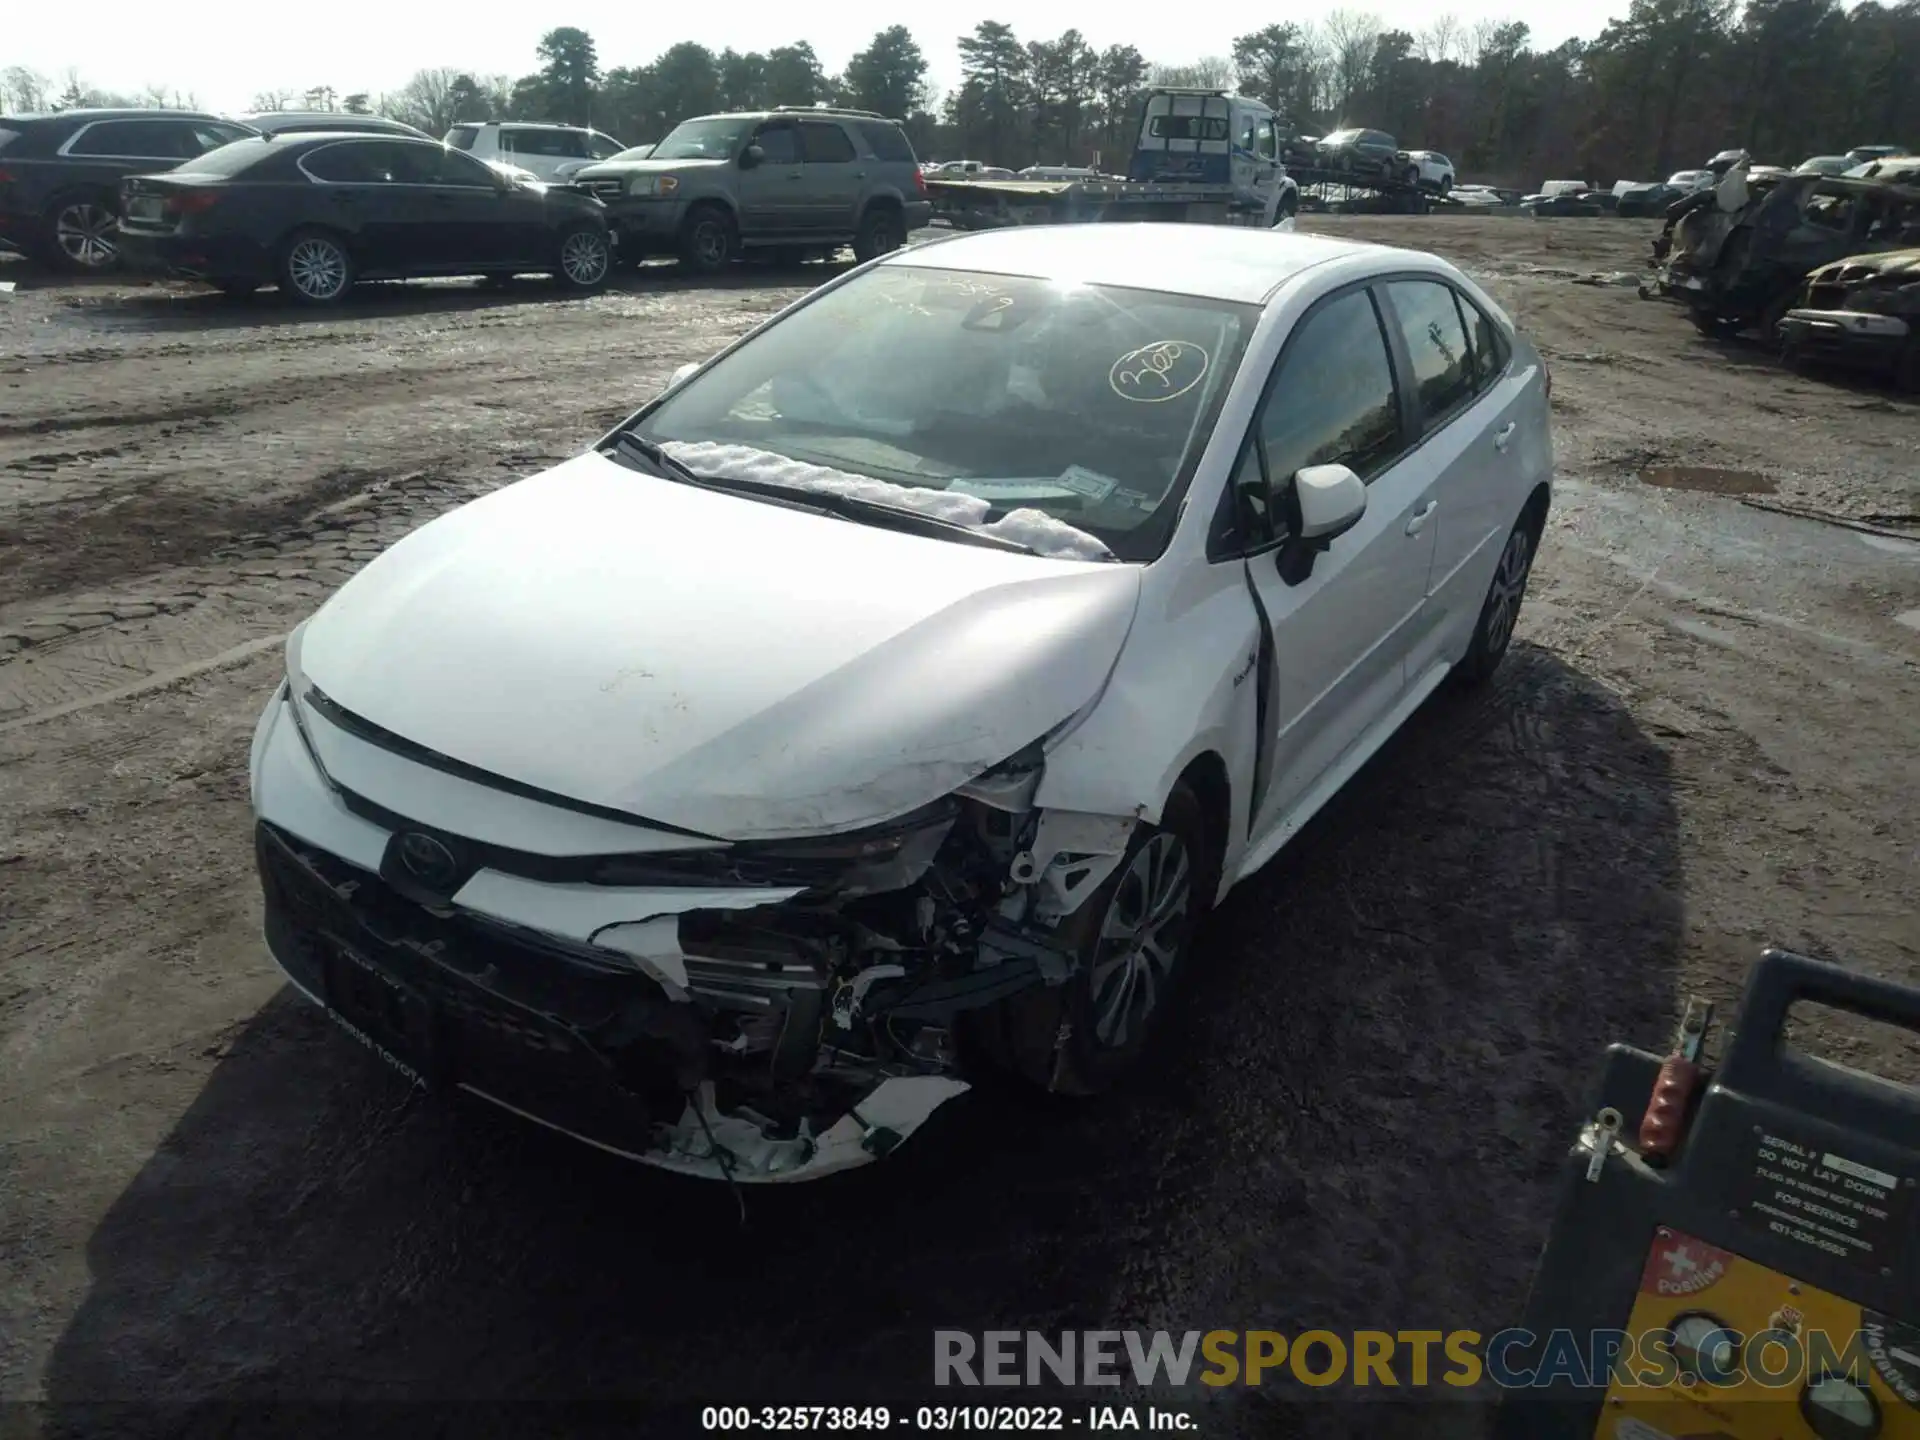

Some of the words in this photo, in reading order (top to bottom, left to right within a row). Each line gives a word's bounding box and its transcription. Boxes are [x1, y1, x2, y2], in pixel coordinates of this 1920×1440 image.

[375, 1043, 428, 1090] TOYOTA
[1761, 1134, 1807, 1157] SERIAL
[1757, 1147, 1778, 1161] DO
[1781, 1156, 1808, 1172] NOT
[1813, 1167, 1840, 1183] LAY
[1844, 1178, 1887, 1200] DOWN
[1775, 1190, 1802, 1208] FOR
[1802, 1200, 1860, 1229] SERVICE
